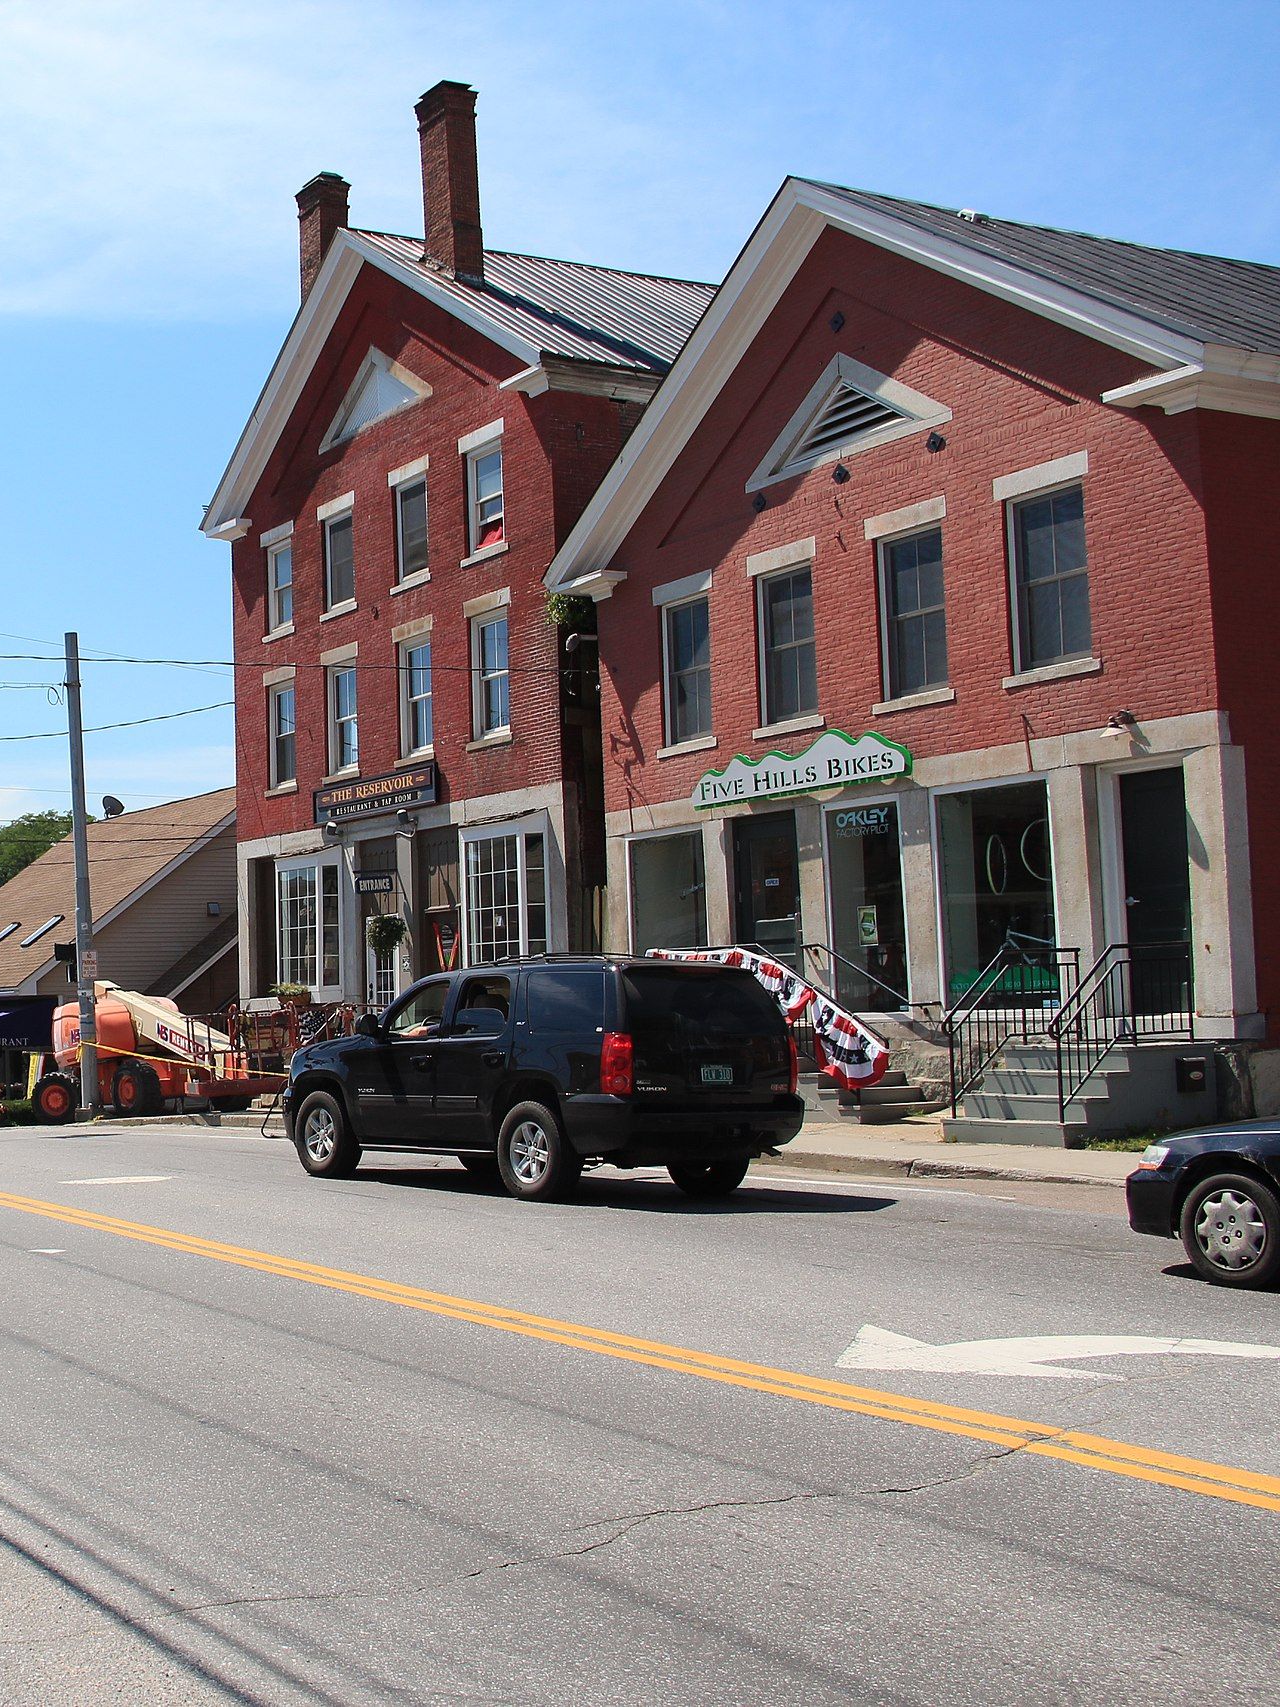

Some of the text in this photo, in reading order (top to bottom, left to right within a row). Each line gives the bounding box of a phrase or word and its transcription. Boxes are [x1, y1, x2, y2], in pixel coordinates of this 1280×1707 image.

[699, 751, 895, 802] FIVE HILLS BIKES
[331, 774, 414, 804] THE RESERVOIR
[336, 792, 413, 816] RESTAURANT & TAP ROOM
[835, 807, 889, 828] OAKLEY
[359, 878, 391, 891] ENTRANCE
